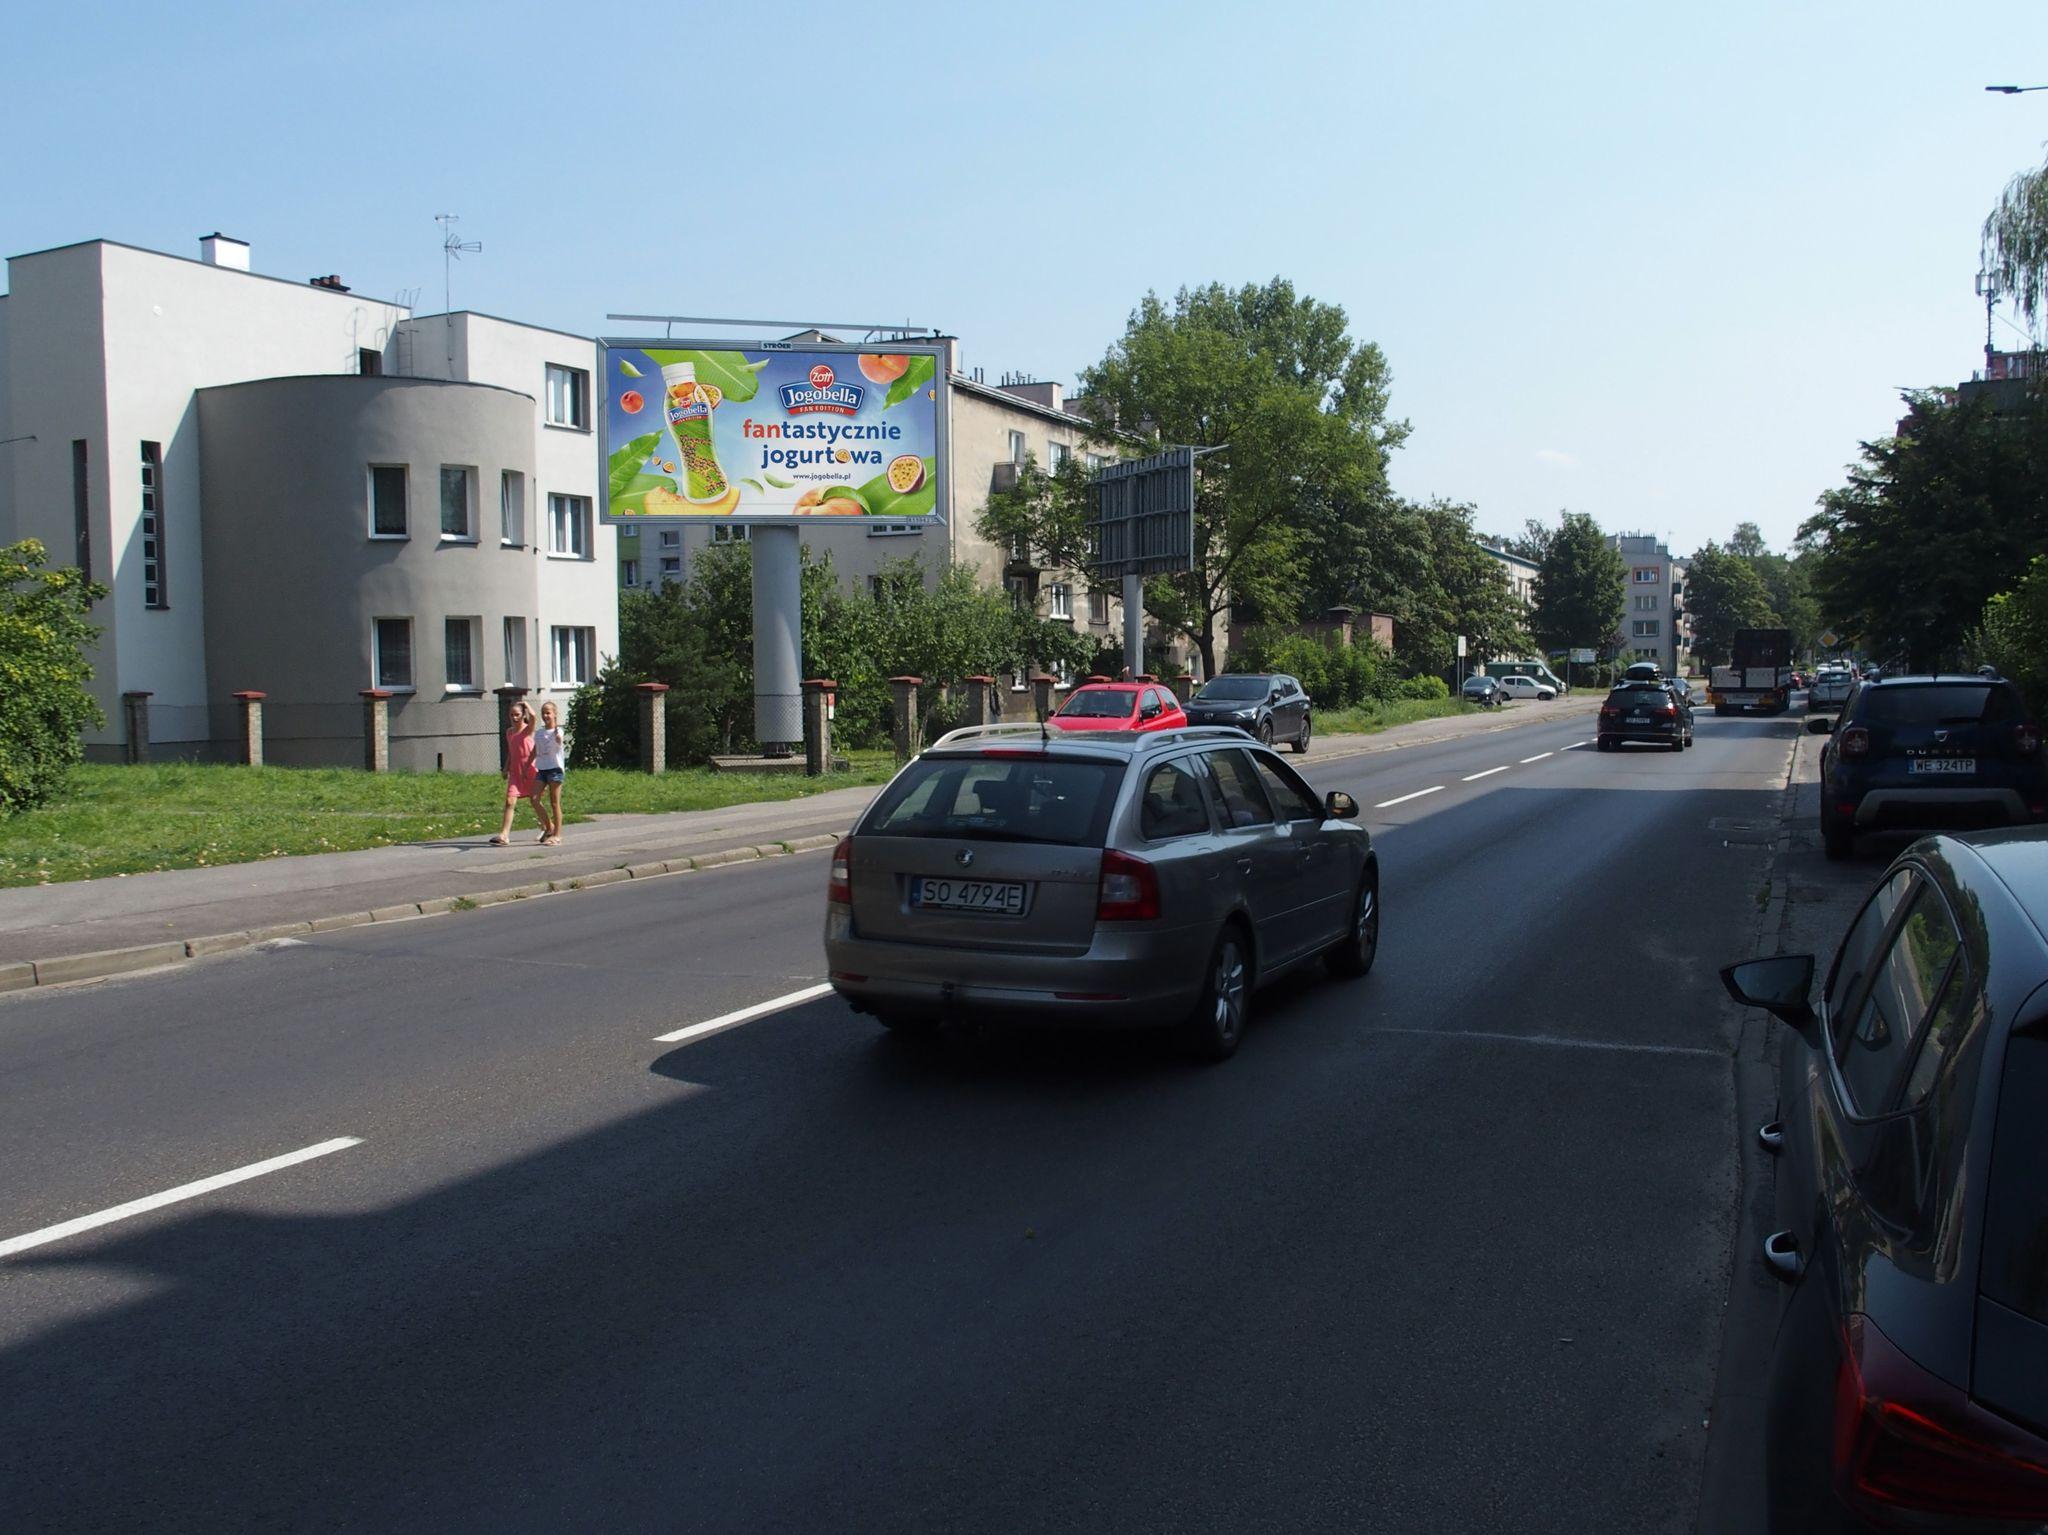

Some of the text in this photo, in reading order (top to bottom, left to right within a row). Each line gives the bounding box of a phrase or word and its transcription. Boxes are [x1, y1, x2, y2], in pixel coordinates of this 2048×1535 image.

[811, 370, 834, 383] Zott
[787, 386, 857, 405] Jogobella
[815, 405, 845, 414] EDITION
[743, 418, 901, 444] fantastycznie
[761, 444, 882, 469] jogurtowa
[793, 472, 851, 481] www.jogobella.pl
[924, 881, 950, 902] SO
[958, 884, 1020, 908] 4794E
